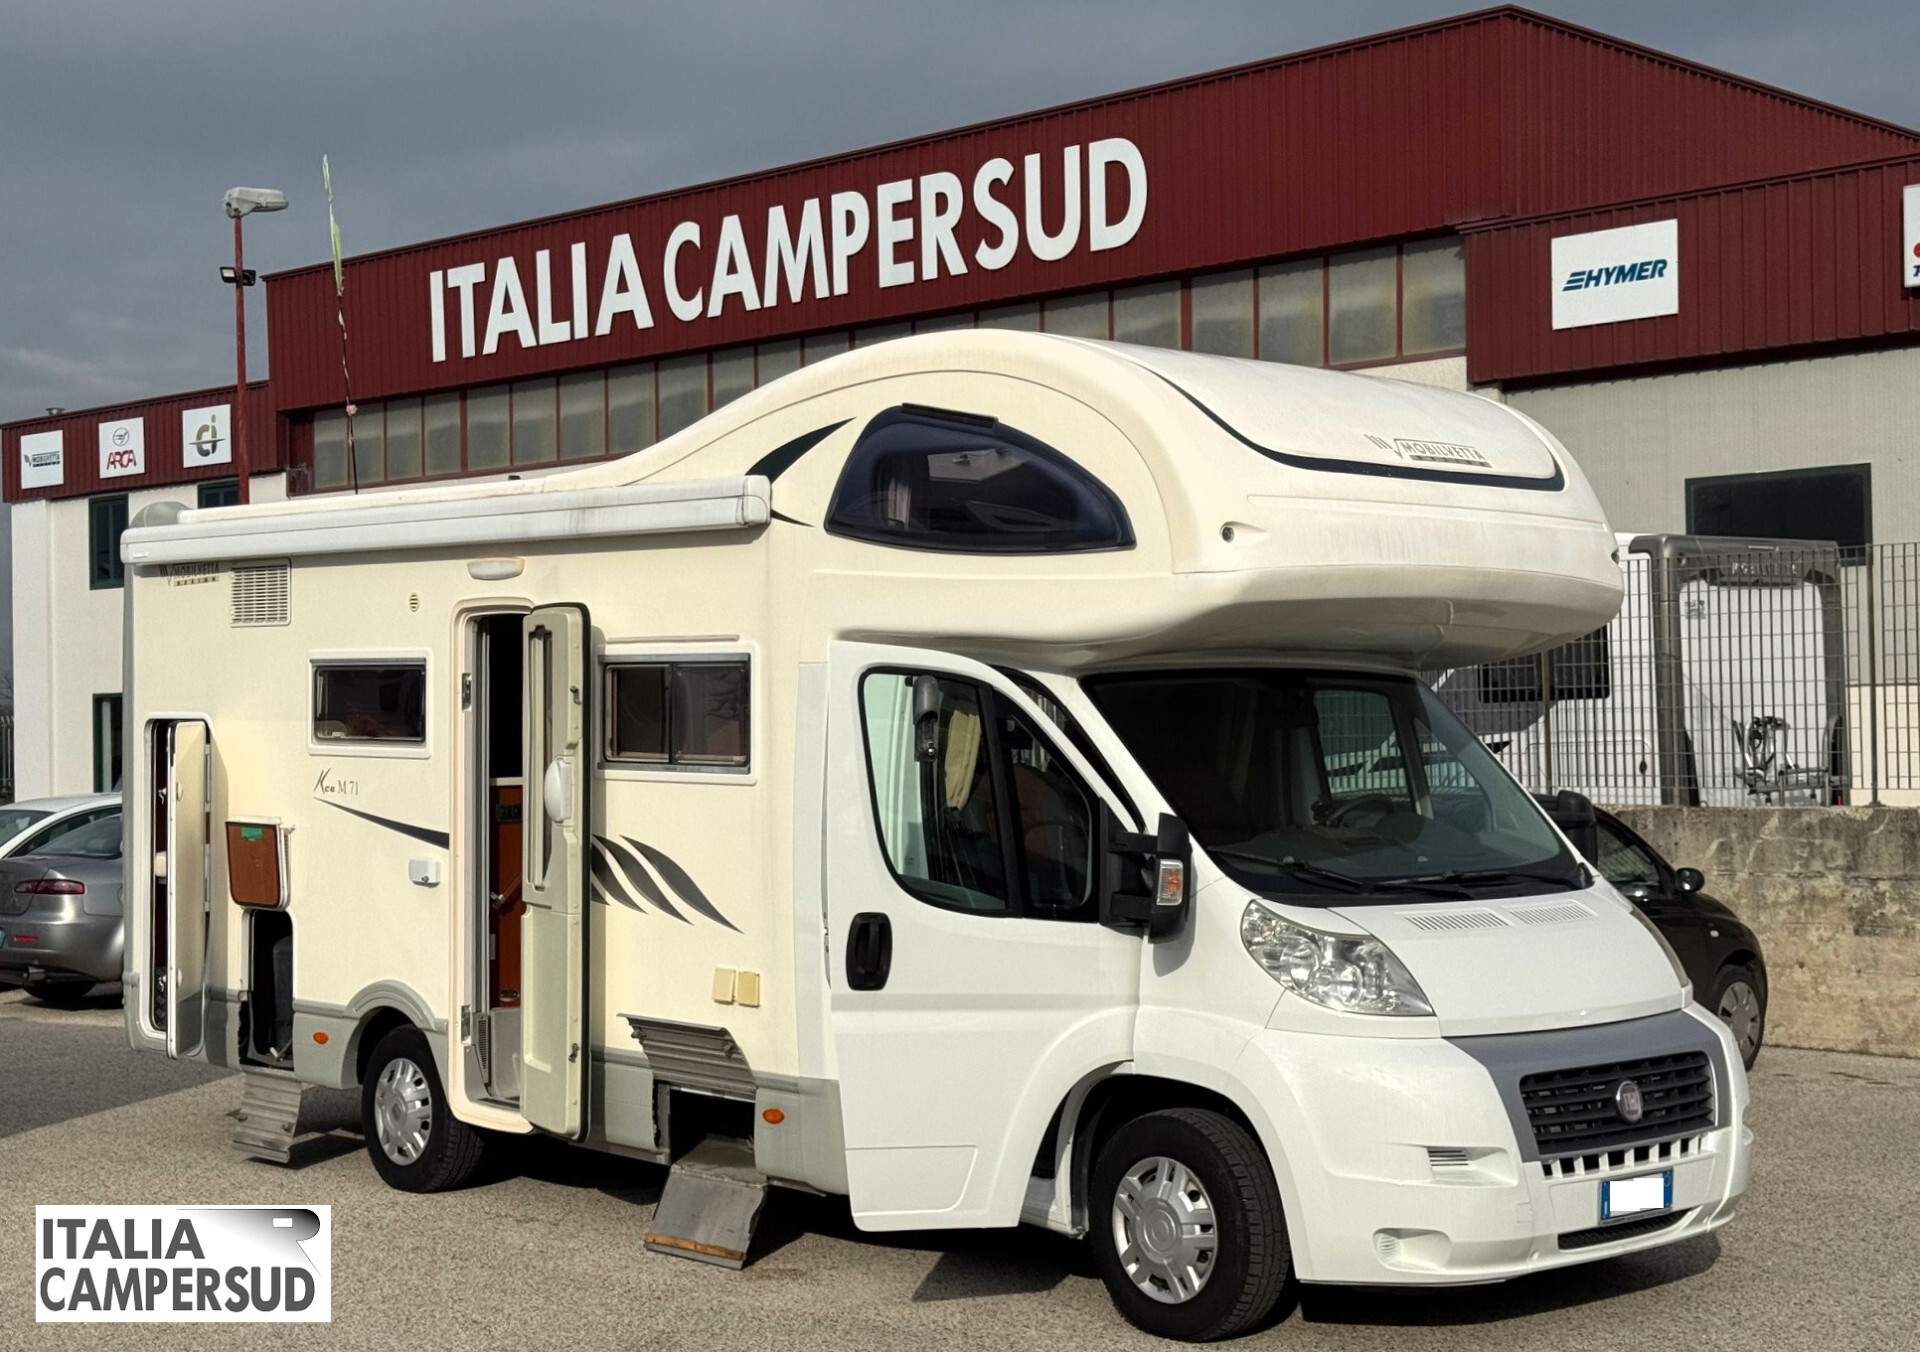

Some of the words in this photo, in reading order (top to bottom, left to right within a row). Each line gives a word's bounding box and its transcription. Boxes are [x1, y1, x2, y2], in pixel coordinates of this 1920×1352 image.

[430, 233, 655, 362] ITALIA
[663, 137, 1148, 322] CAMPERSUD
[1583, 258, 1668, 288] HYMER
[106, 449, 137, 470] ARCA
[1400, 441, 1487, 461] MOBILVETTA
